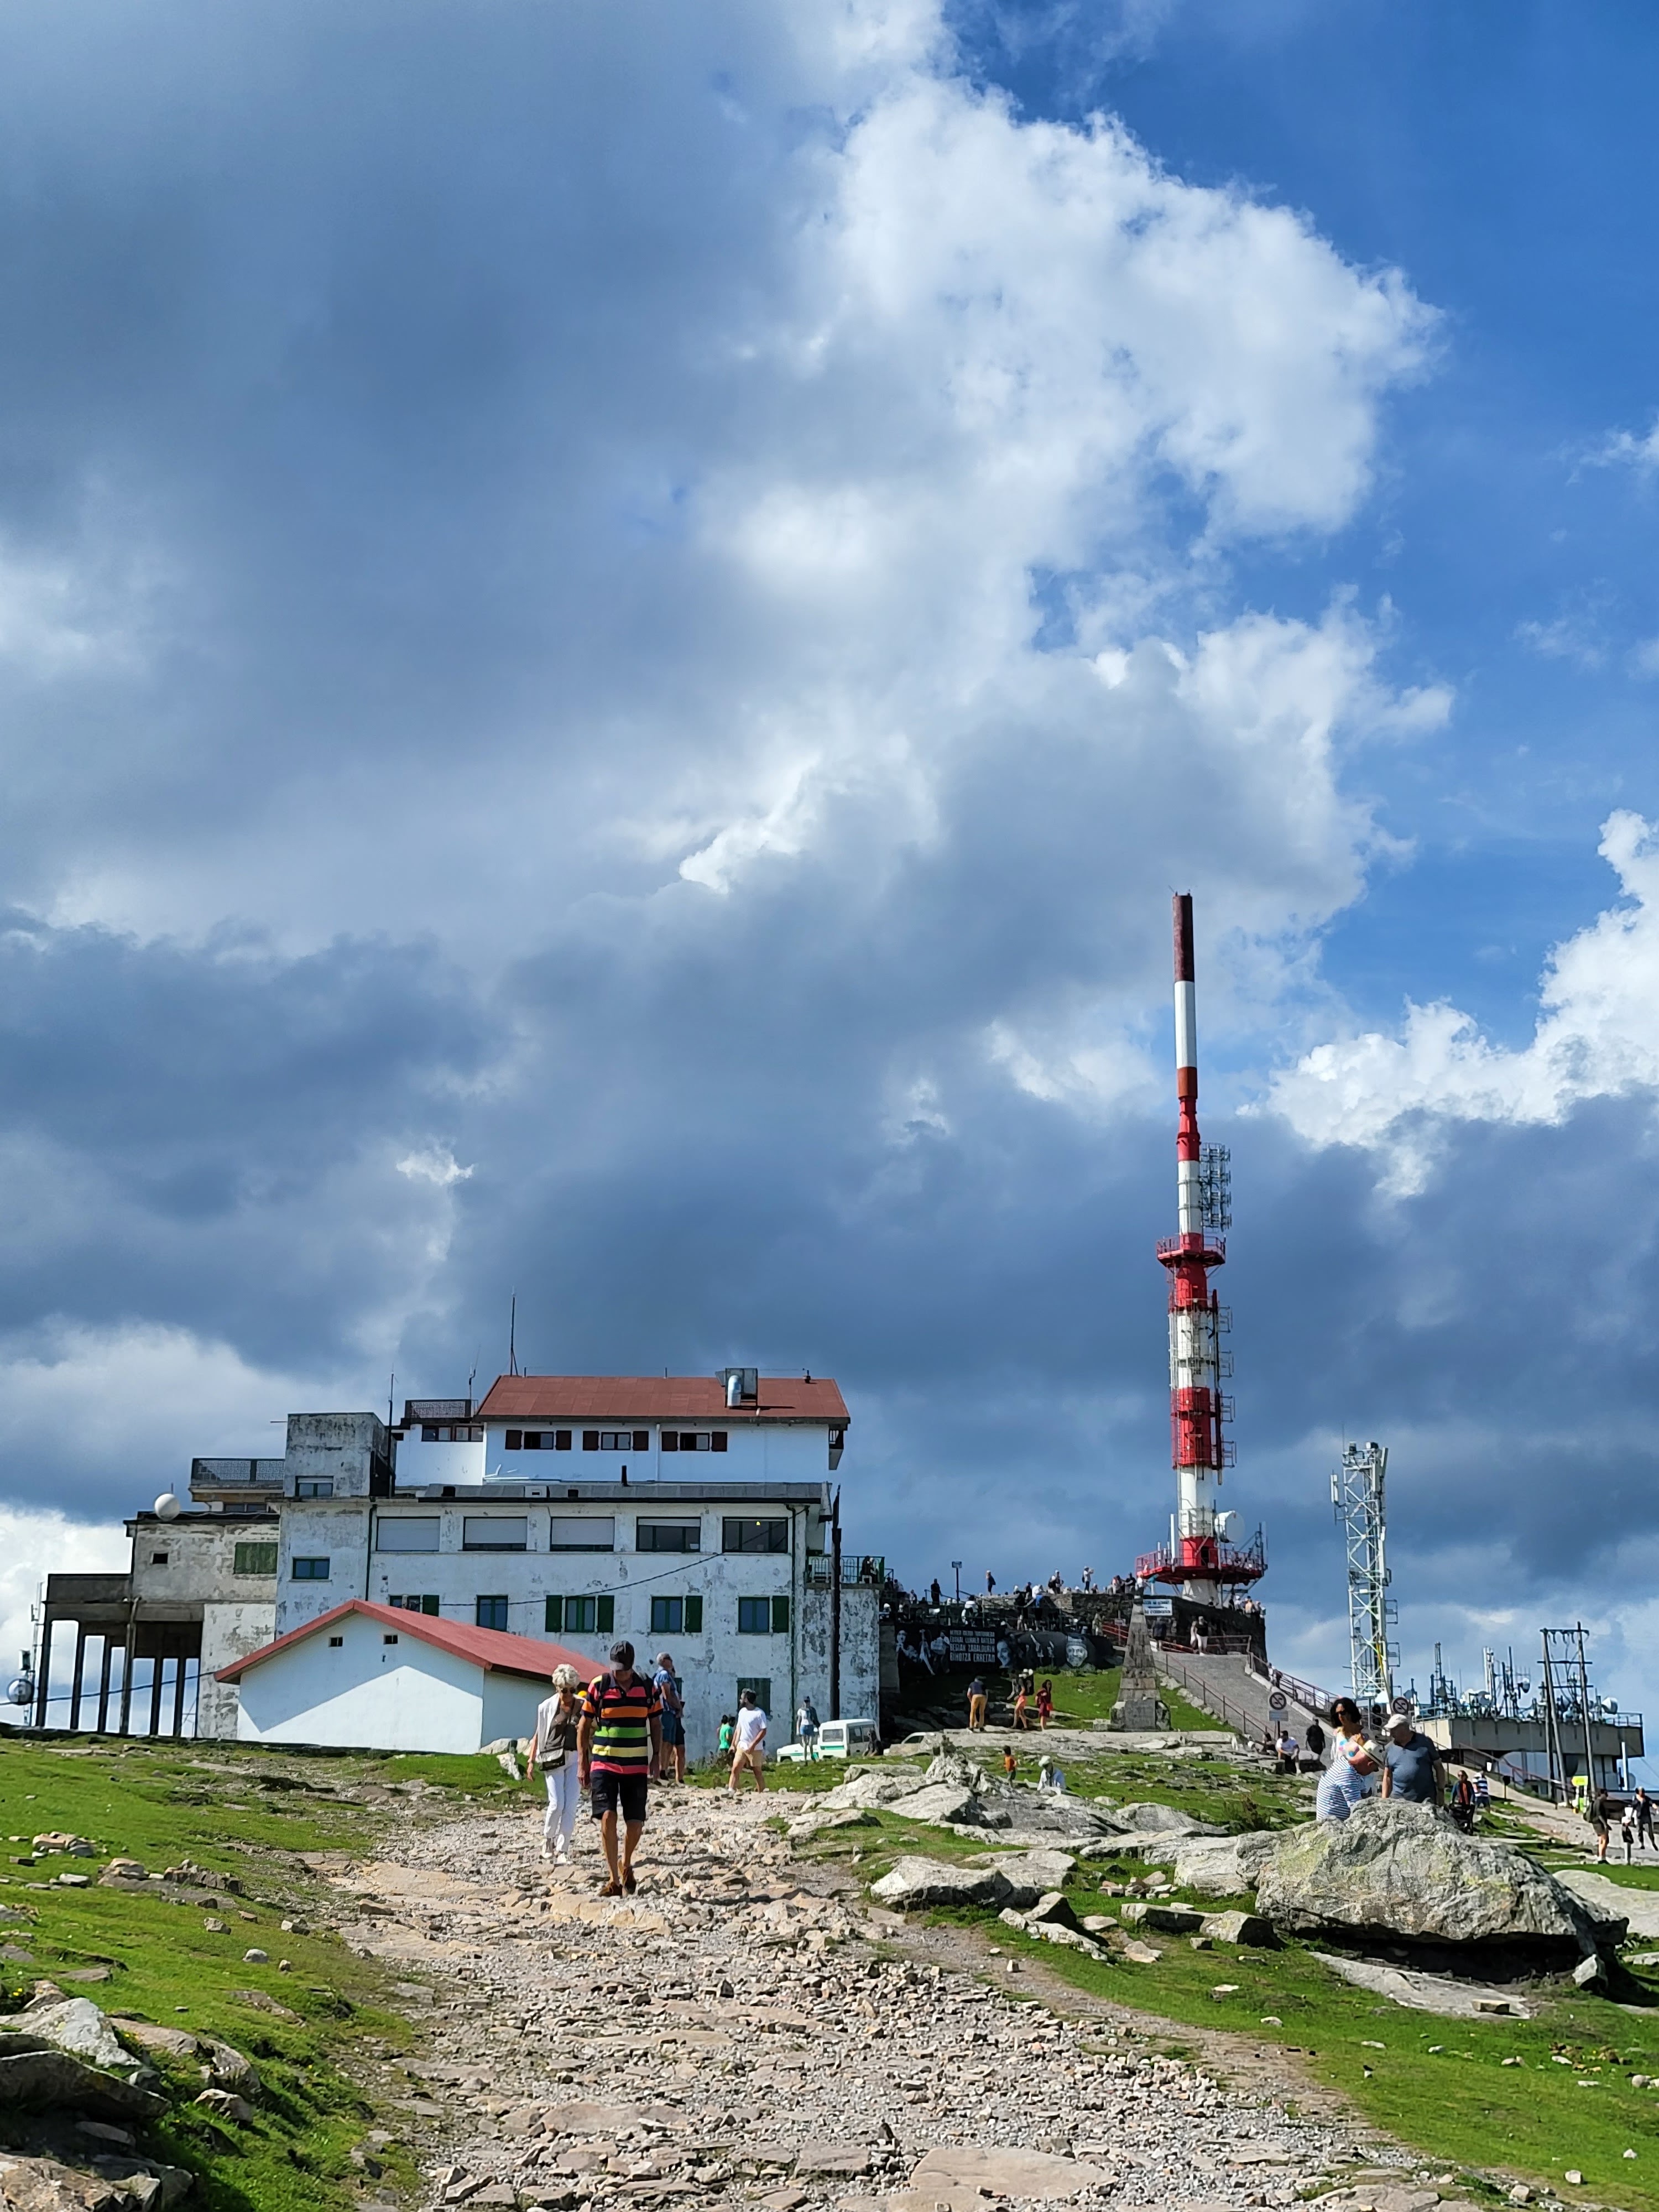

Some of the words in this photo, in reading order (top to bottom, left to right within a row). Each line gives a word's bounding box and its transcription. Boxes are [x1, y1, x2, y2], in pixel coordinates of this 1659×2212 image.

[968, 1645, 995, 1653] ZABALDURIK
[950, 1652, 971, 1661] BIHOTZA
[973, 1653, 995, 1662] ERRETAN
